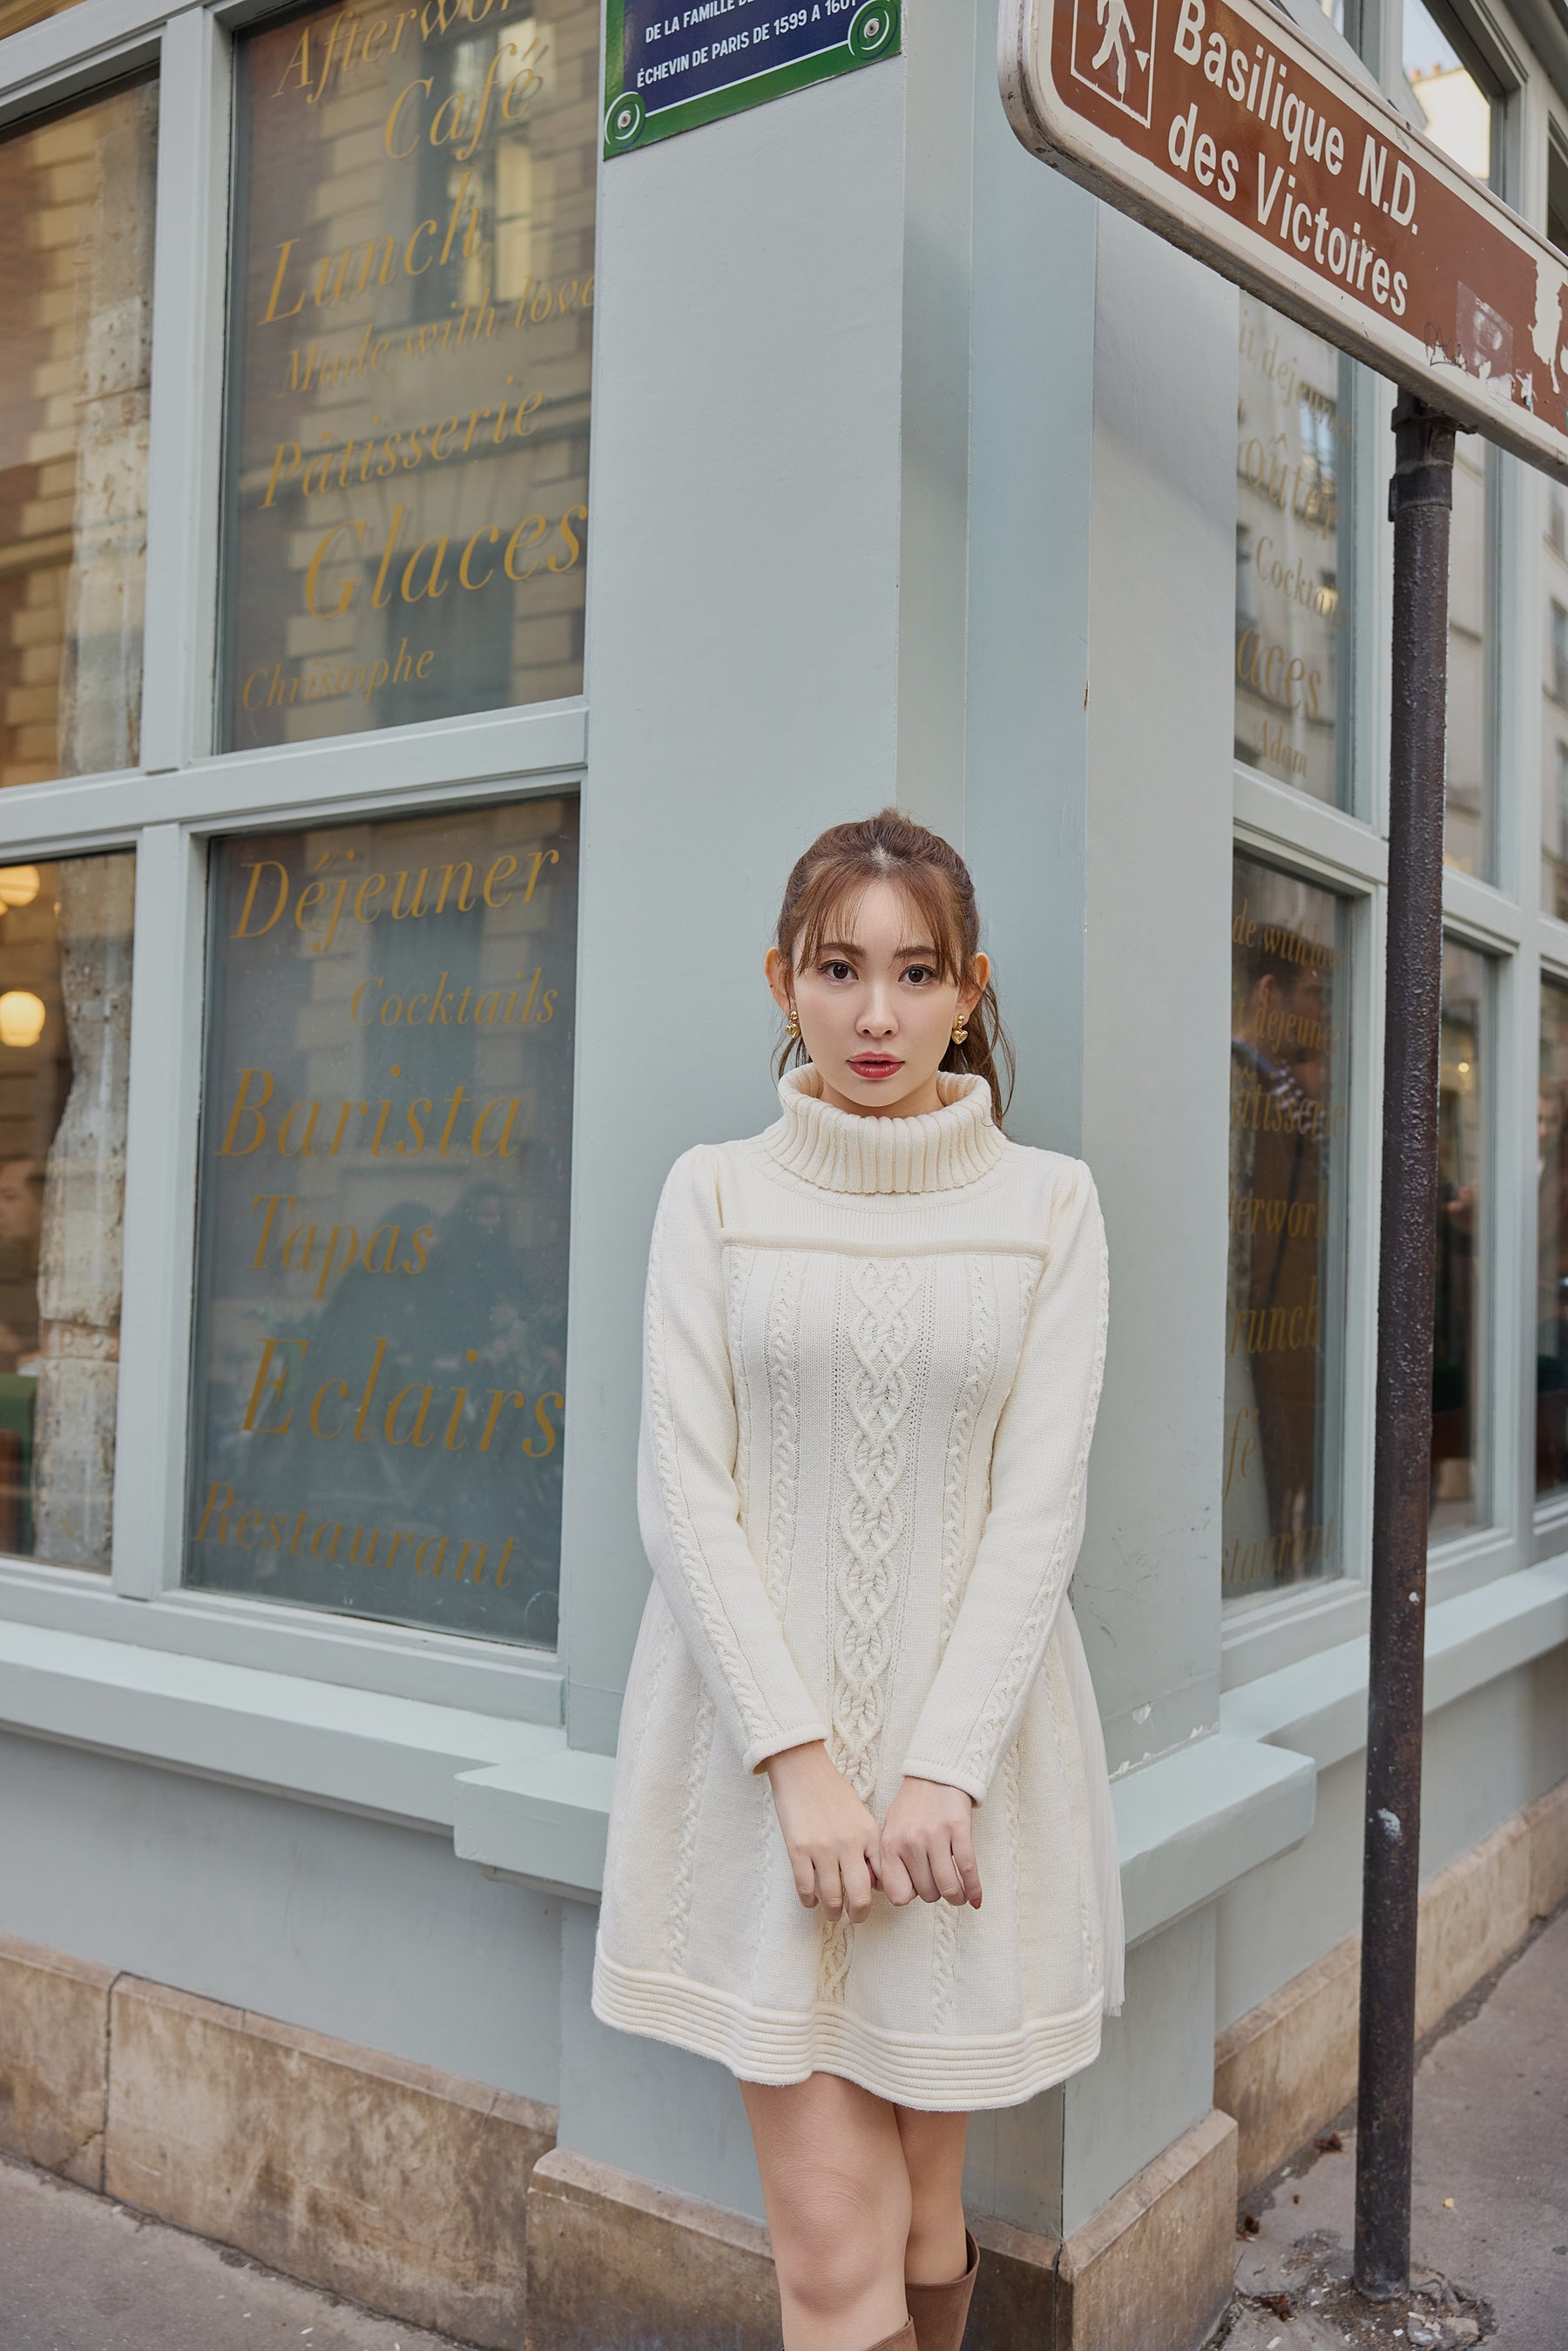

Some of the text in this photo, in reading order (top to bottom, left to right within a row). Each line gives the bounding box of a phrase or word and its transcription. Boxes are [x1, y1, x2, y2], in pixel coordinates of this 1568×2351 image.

[271, 0, 510, 103] Afterwo
[636, 53, 690, 88] ÉCHEVIN
[692, 46, 709, 67] DE
[712, 31, 749, 60] PARIS
[753, 24, 770, 44] DE
[773, 9, 808, 36] 1599
[811, 4, 821, 22] A
[645, 0, 735, 44] DE LA FAMILLE
[385, 36, 541, 161] Café
[1173, 0, 1420, 235] Basilique N.D.
[258, 173, 483, 326] Lunch
[1168, 103, 1408, 317] des Victoires
[278, 323, 390, 398] Made
[406, 287, 496, 358] with
[258, 375, 544, 511] Pâtisserie
[1237, 433, 1338, 540] oûter
[304, 503, 589, 621] Glaces
[242, 638, 436, 712] Christophe
[228, 849, 560, 954] Déjeuner
[1263, 918, 1307, 967] with
[351, 966, 559, 1026] Cocktails
[213, 1063, 522, 1158] Barista
[244, 1193, 435, 1299] Tapas
[236, 1338, 564, 1458] Eclairs
[190, 1481, 520, 1589] Restaurant
